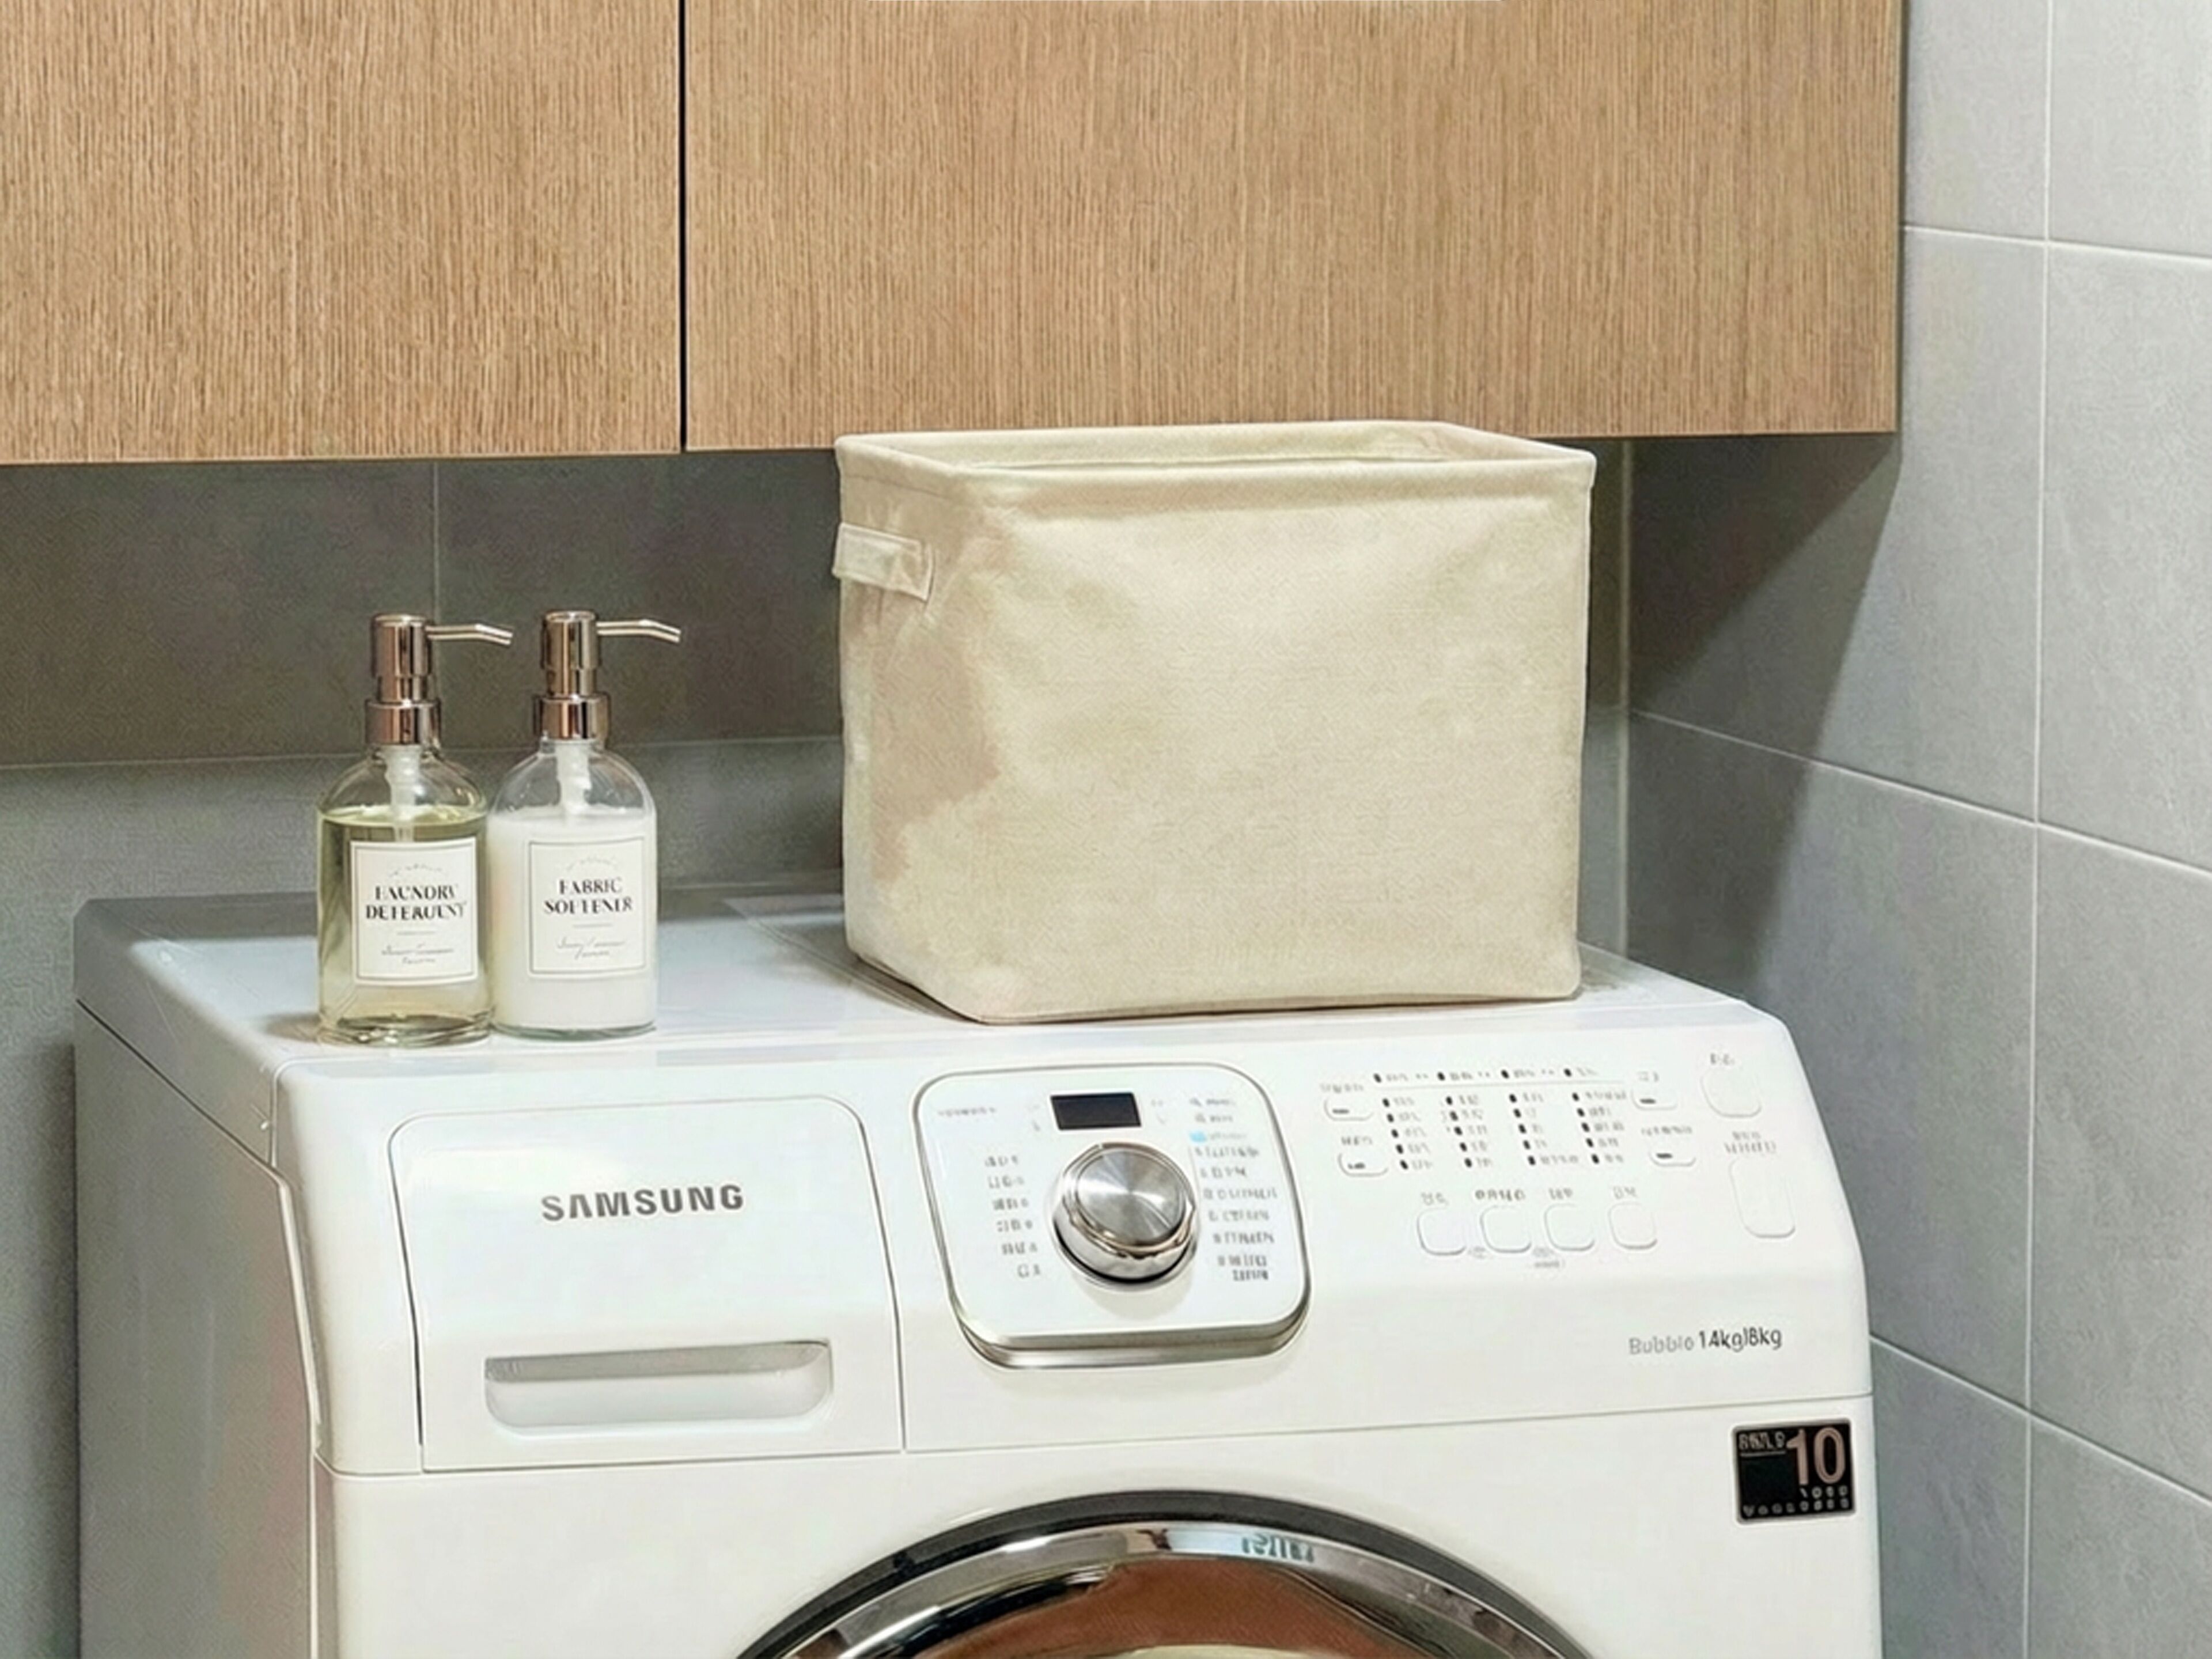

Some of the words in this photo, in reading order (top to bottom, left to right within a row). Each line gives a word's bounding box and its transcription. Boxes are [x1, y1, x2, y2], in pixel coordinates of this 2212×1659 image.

[559, 877, 622, 895] FABRIC
[541, 1184, 744, 1221] SAMSUNG
[1786, 1427, 1846, 1485] 10
